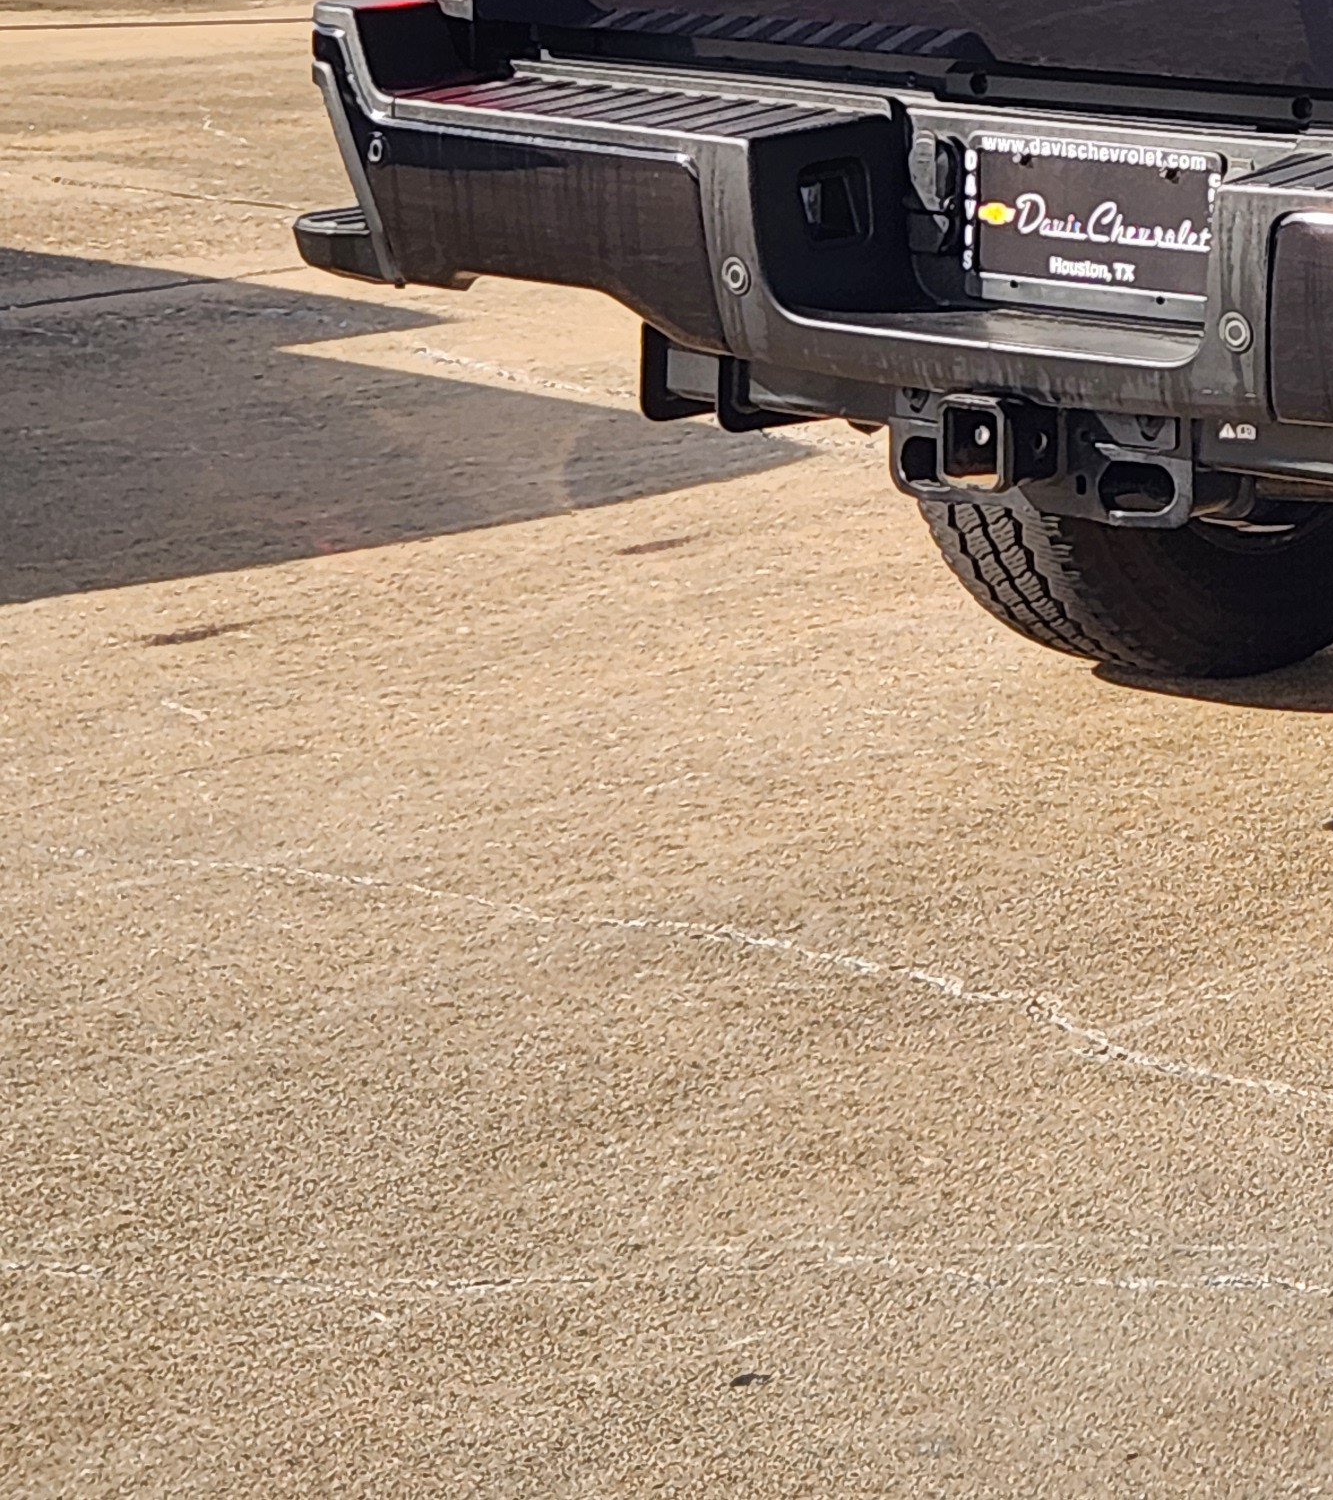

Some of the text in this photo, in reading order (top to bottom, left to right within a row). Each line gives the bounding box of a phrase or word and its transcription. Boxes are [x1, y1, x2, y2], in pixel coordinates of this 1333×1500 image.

[981, 136, 1207, 171] www.davischevrolet.com
[1016, 192, 1213, 253] Davis Chevrolet
[1049, 255, 1136, 283] Houston, TX
